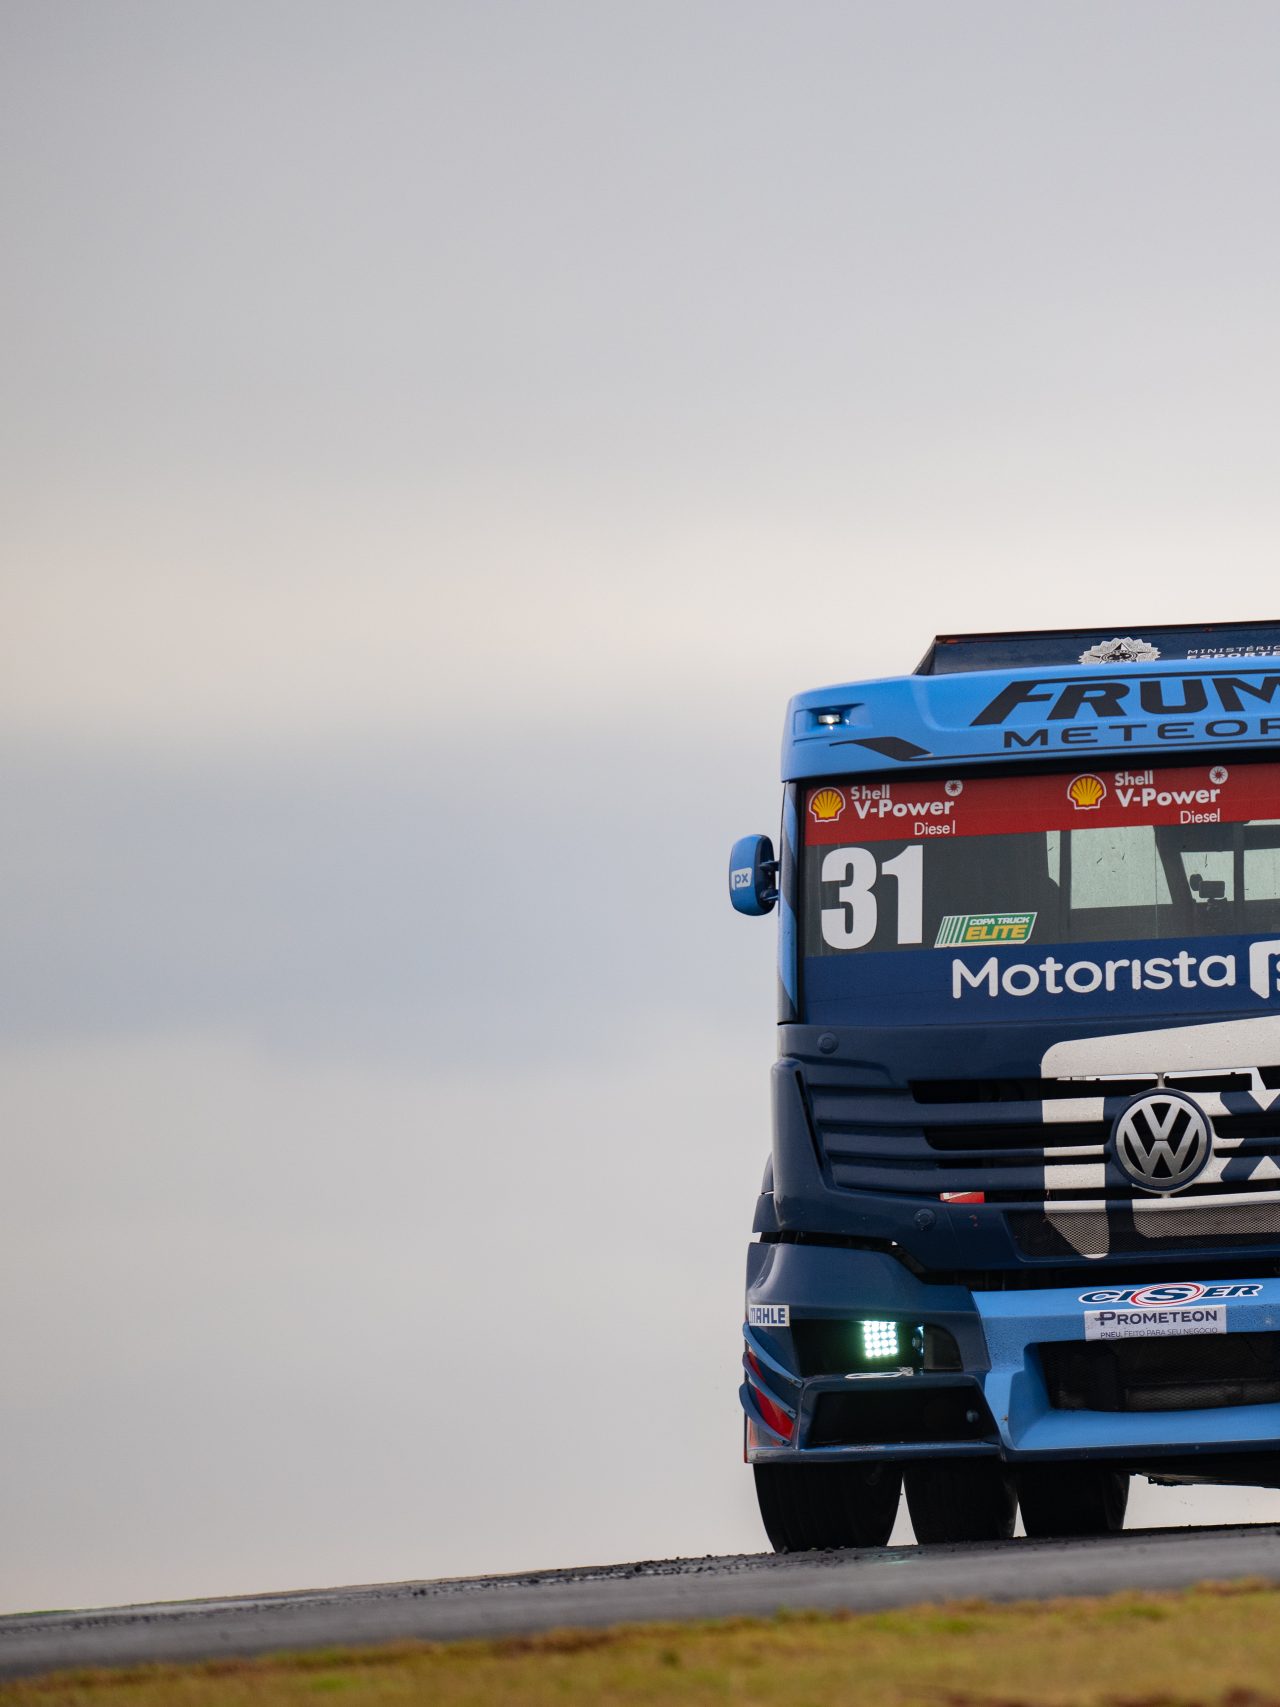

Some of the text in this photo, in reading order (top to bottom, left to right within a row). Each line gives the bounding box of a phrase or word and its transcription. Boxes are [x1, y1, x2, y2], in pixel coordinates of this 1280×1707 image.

[1114, 771, 1153, 786] Shell
[850, 785, 890, 800] Shell
[1115, 787, 1220, 808] V-Power
[854, 799, 954, 820] V-Power
[1180, 809, 1220, 825] Diesel
[914, 820, 956, 836] Diesel
[821, 845, 923, 950] 31
[965, 924, 1028, 941] ELITE
[952, 951, 1236, 999] Motorista
[1081, 1284, 1262, 1306] CISER
[750, 1307, 786, 1324] MAHLE
[1095, 1310, 1218, 1326] PROMETEON
